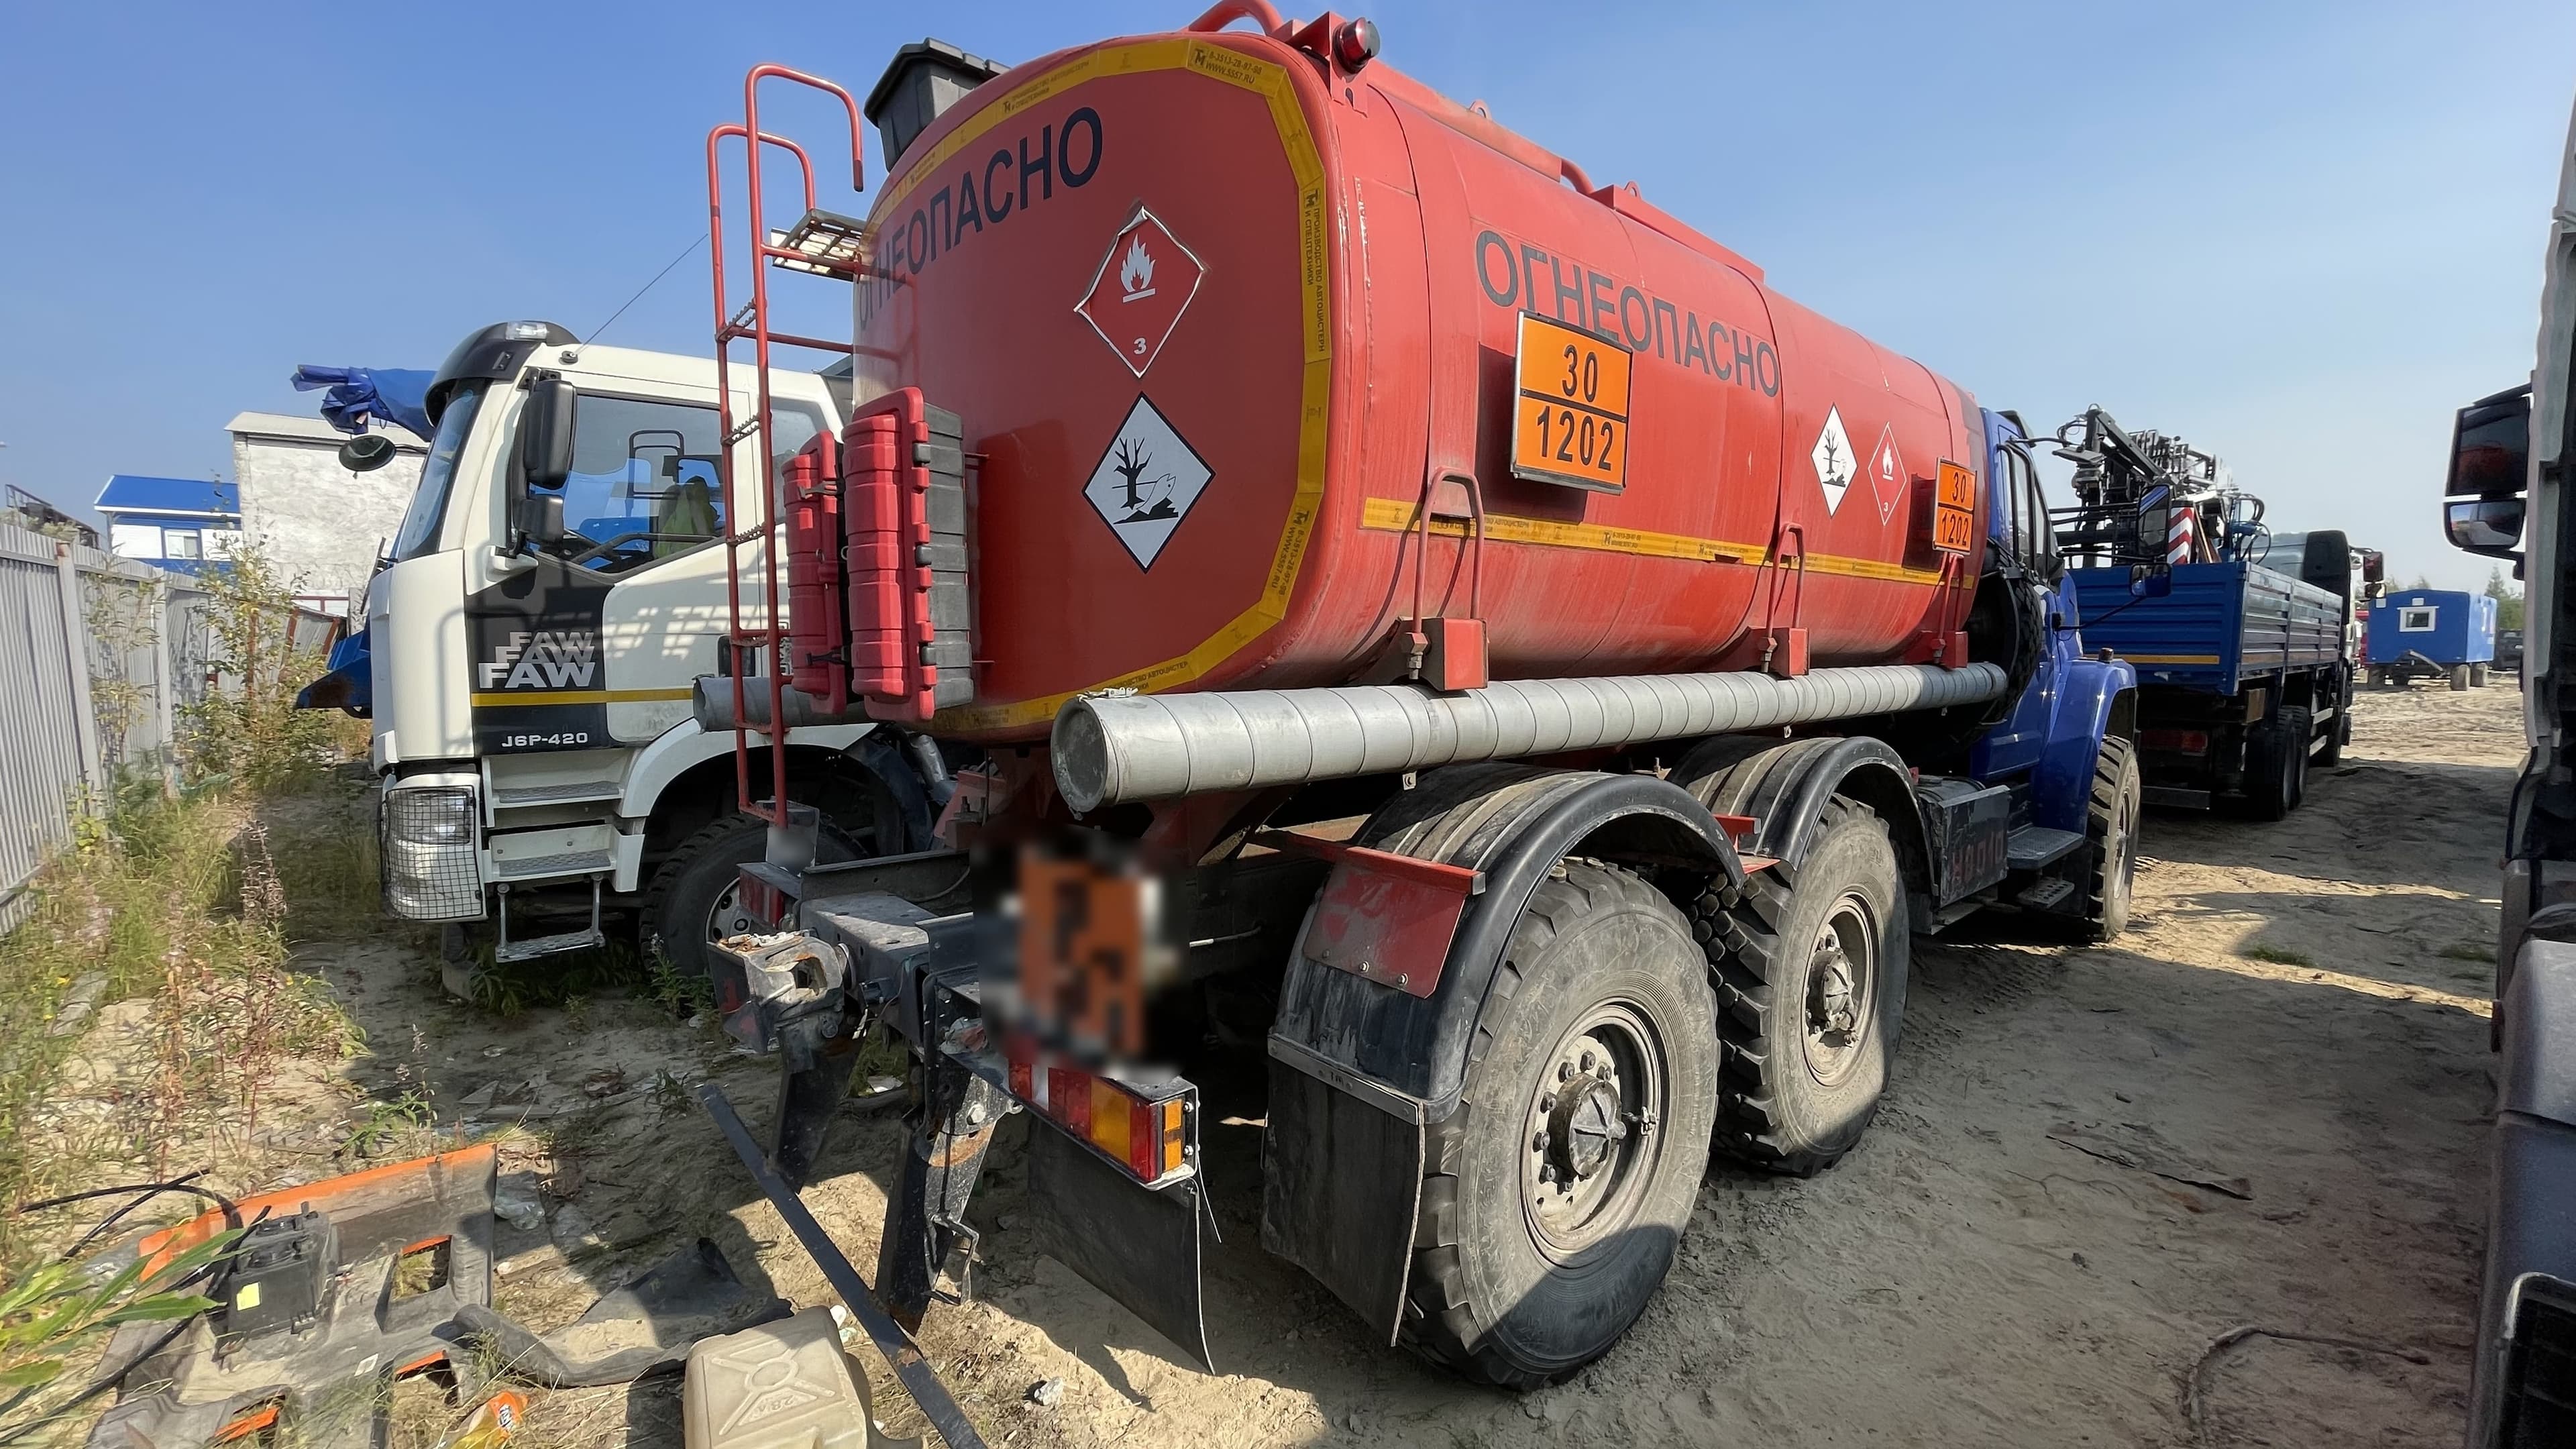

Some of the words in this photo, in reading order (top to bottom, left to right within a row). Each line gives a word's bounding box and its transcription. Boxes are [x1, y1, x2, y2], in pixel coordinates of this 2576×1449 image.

[859, 107, 1102, 329] ОГНЕОПАСНО
[1305, 219, 1313, 286] СПЕЦТЕХНИКИ
[1313, 208, 1322, 282] ПРОИЗВОДСТВО
[1316, 284, 1325, 352] АВТОЦИСТЕРН
[1477, 230, 1779, 397] ОГНЕОПАСНО
[1134, 337, 1146, 354] 3
[1562, 345, 1598, 402] 30
[1537, 405, 1613, 472] 1202
[1952, 472, 1966, 503] 30
[1883, 502, 1889, 512] 3
[1941, 512, 1969, 546] 1202
[495, 646, 595, 667] FAW
[510, 632, 594, 649] FAW
[478, 662, 596, 689] FAW
[502, 732, 588, 747] J6P-420
